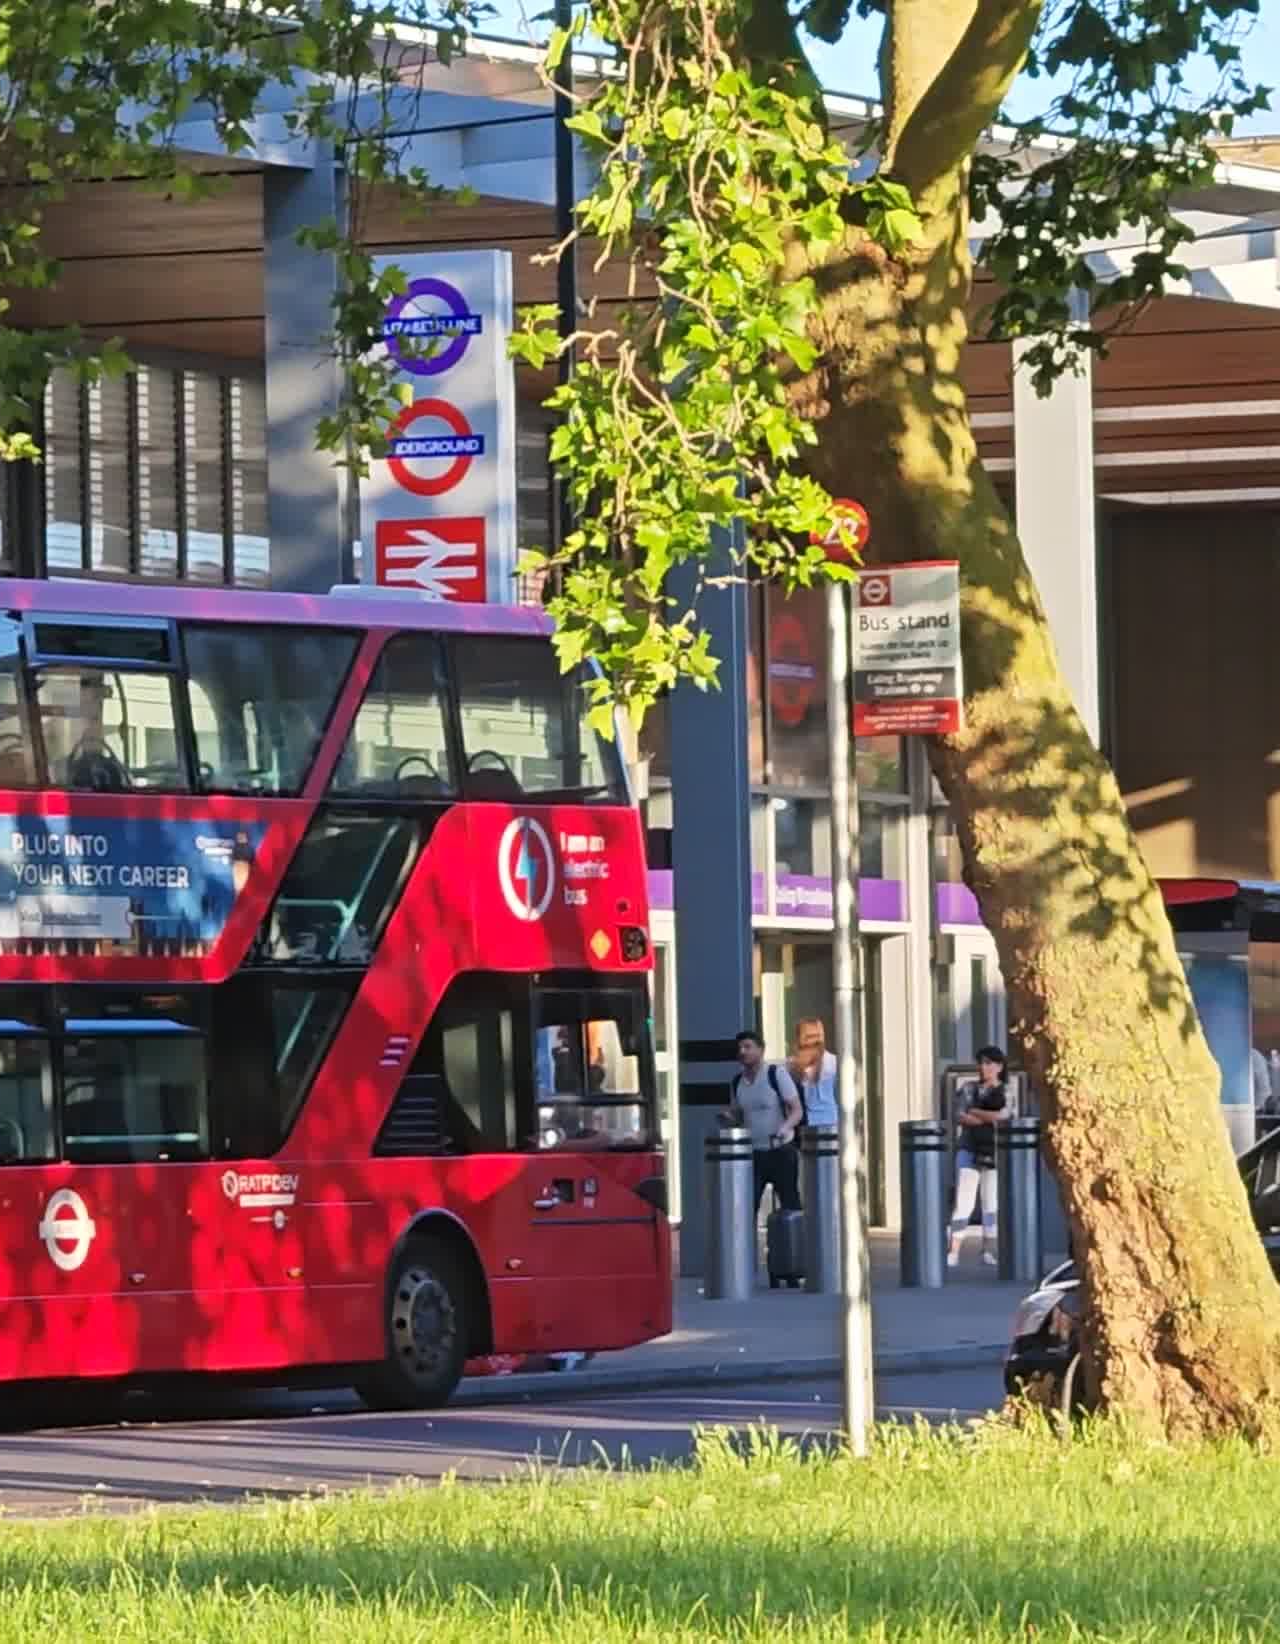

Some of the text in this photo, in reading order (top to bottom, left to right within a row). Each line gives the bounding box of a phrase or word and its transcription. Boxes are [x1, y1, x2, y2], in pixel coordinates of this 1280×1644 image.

[859, 611, 950, 631] Bus stand
[11, 833, 109, 858] PLUG INTO
[13, 862, 190, 889] YOUR NEXT CAREER
[564, 884, 588, 906] bus
